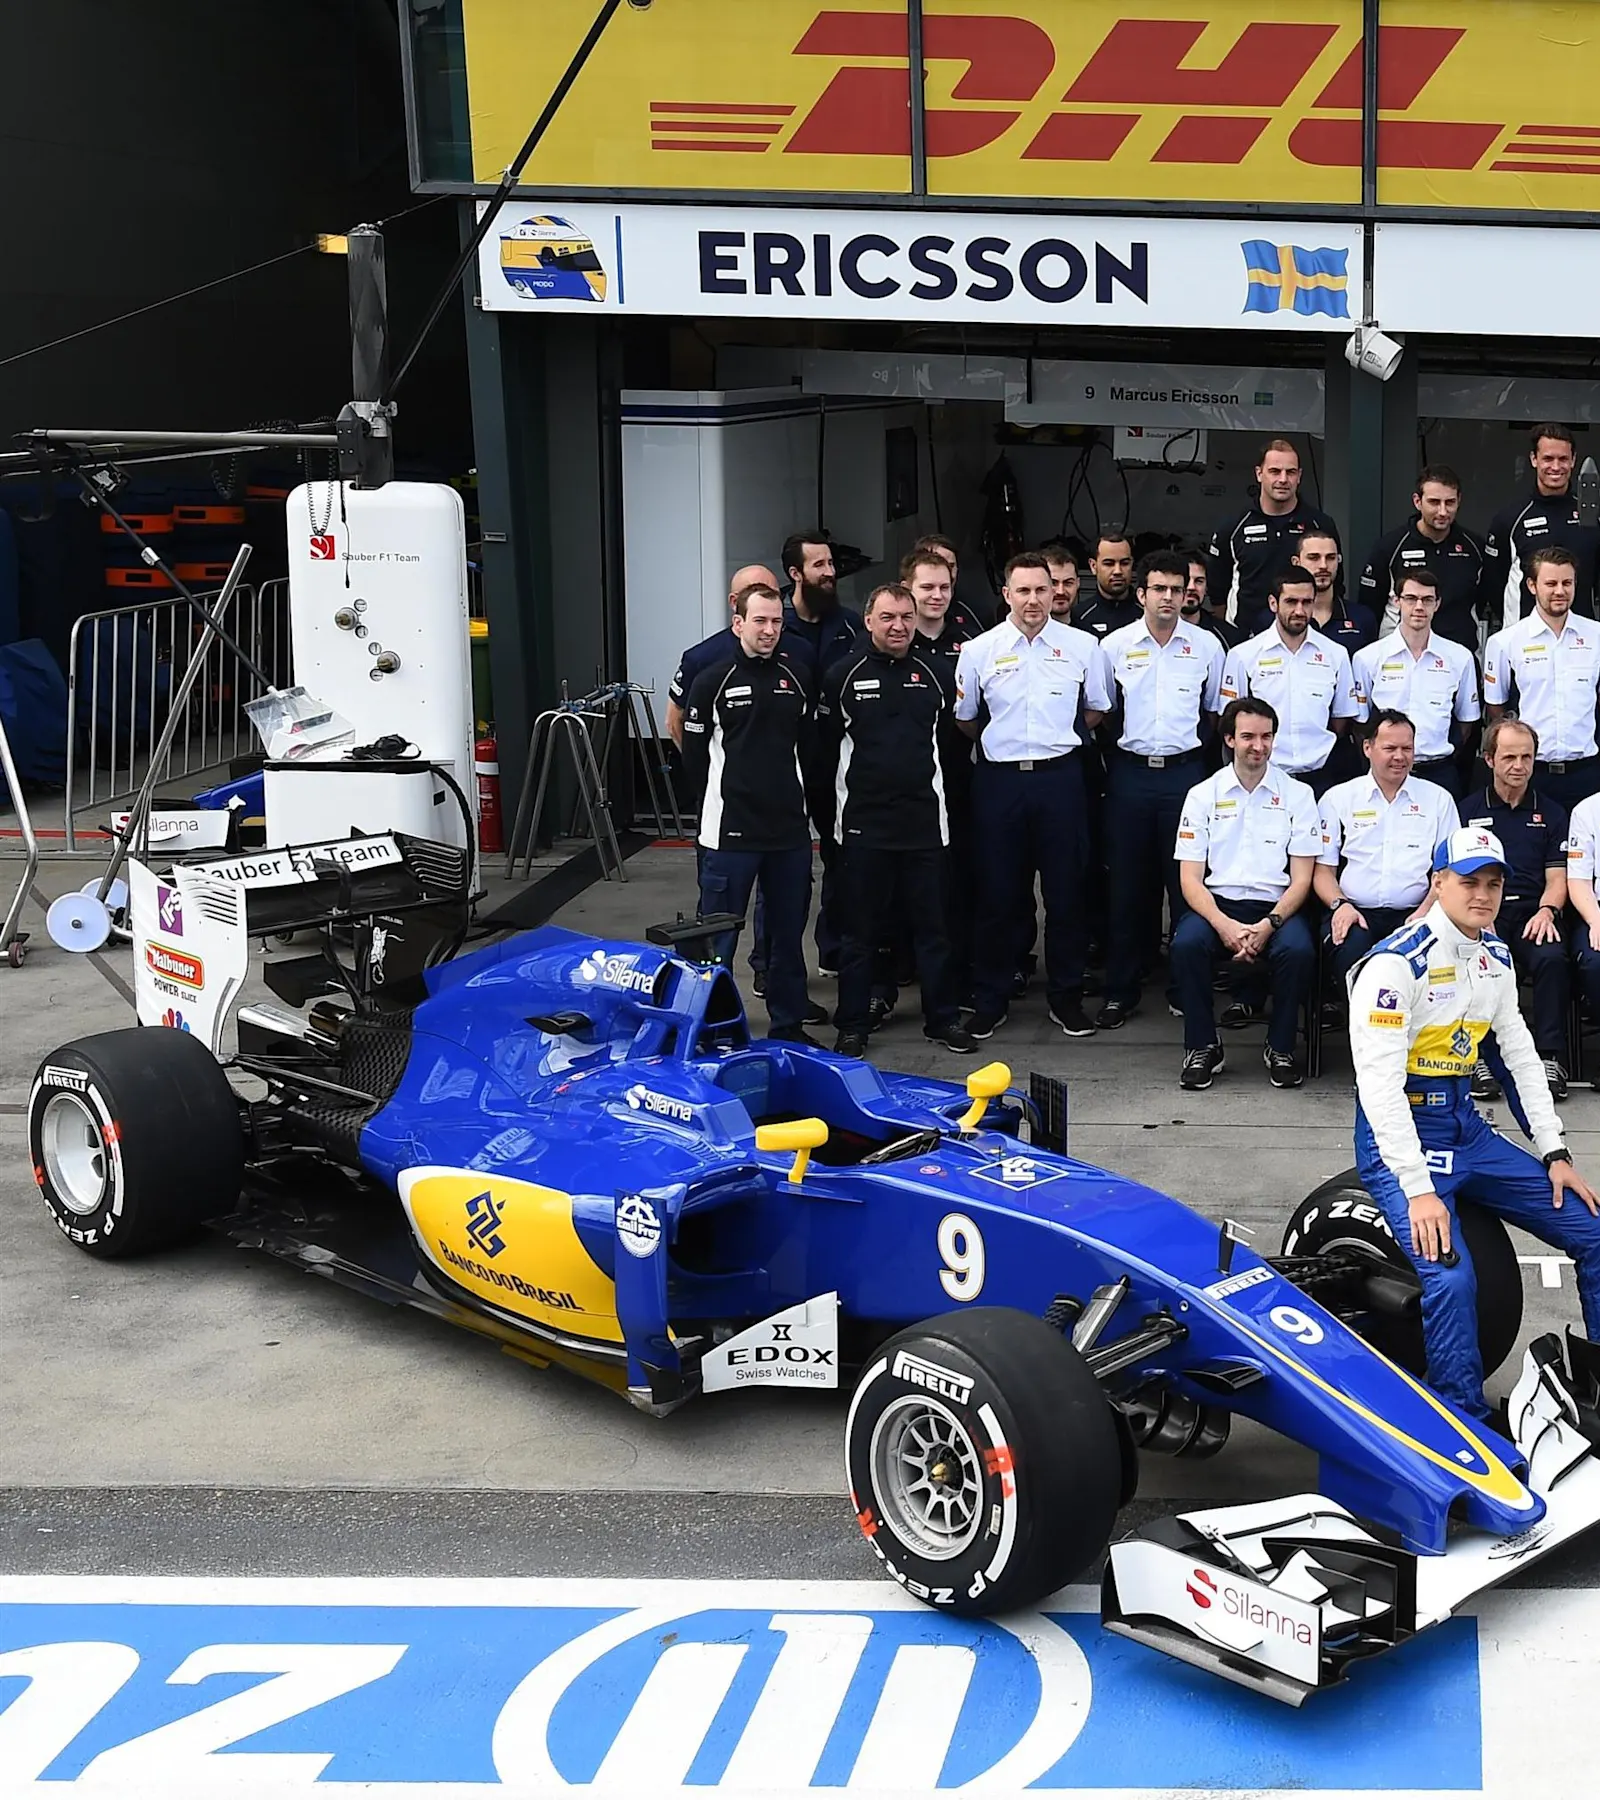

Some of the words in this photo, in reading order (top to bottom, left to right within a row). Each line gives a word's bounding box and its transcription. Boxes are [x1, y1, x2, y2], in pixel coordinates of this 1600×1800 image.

[783, 11, 1507, 171] DHL
[698, 231, 1149, 305] ERICSSON
[1084, 386, 1096, 400] 9
[1110, 386, 1168, 404] Marcus
[1171, 388, 1240, 406] Ericsson
[341, 552, 376, 562] Sauber
[379, 553, 391, 562] F1
[395, 553, 420, 563] Team
[323, 842, 390, 864] Team
[154, 977, 179, 996] POWER
[603, 959, 655, 995] Silanna
[43, 1065, 89, 1093] PIRELLI
[1417, 1057, 1452, 1071] BANCO
[645, 1092, 693, 1122] Silanna
[1303, 1207, 1319, 1235] P
[937, 1212, 986, 1303] 9
[438, 1238, 490, 1282] BANCO
[489, 1270, 514, 1292] DO
[510, 1273, 585, 1312] BRASIL
[1202, 1266, 1275, 1301] PIRELLI
[1269, 1305, 1325, 1345] 9
[727, 1346, 835, 1366] EDOX
[736, 1368, 772, 1381] Swiss
[775, 1366, 827, 1381] Watches
[892, 1350, 976, 1406] PIRELLI
[968, 1569, 987, 1599] P
[1223, 1587, 1312, 1646] Silanna
